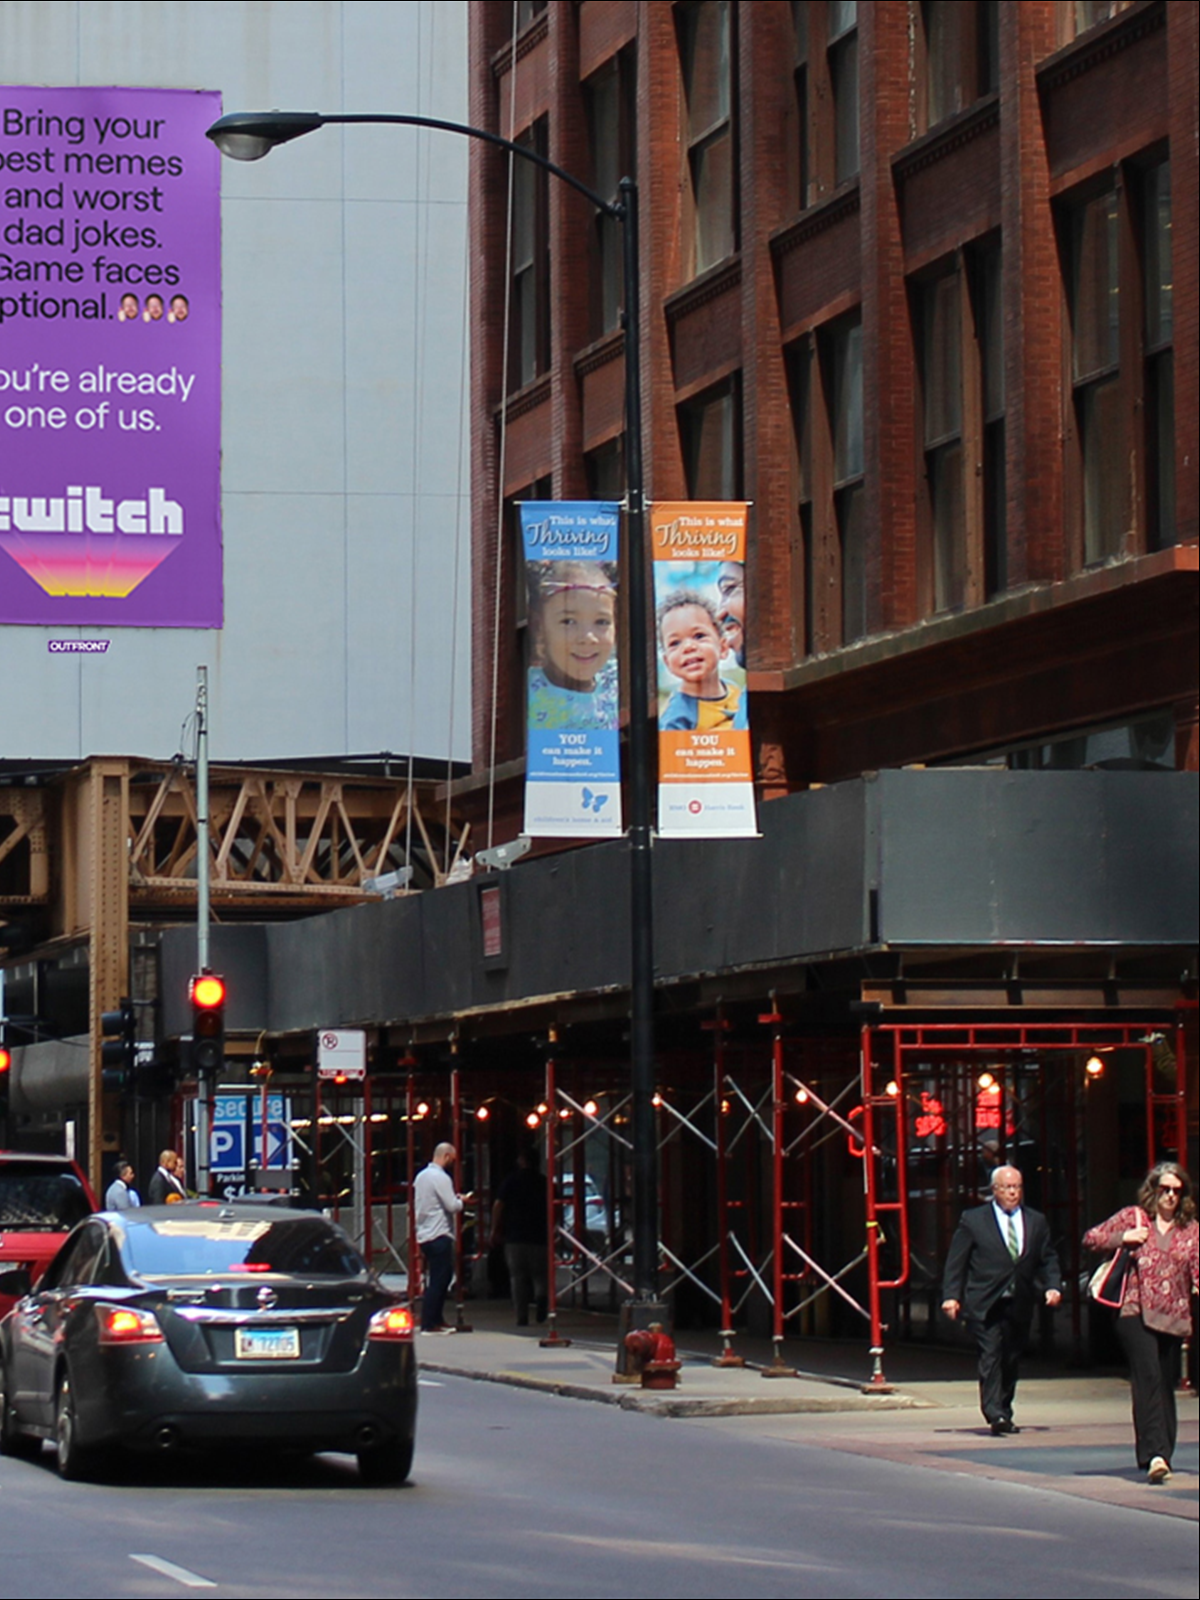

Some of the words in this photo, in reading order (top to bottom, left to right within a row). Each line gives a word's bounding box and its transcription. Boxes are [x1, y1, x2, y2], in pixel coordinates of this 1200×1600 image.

[3, 108, 85, 144] Bring
[94, 117, 165, 144] your
[65, 152, 183, 176] memes
[4, 183, 64, 209] and
[73, 186, 163, 212] worst
[3, 218, 64, 245] dad
[71, 219, 163, 253] jokes.
[92, 256, 180, 285] faces
[78, 365, 195, 401] already
[4, 406, 67, 428] one
[75, 402, 109, 429] of
[118, 409, 161, 431] us.
[549, 516, 574, 525] This
[577, 516, 587, 525] is
[589, 516, 616, 526] what
[678, 516, 703, 526] This
[705, 516, 715, 526] is
[717, 516, 744, 526] what
[526, 519, 610, 554] Thriving
[655, 519, 737, 555] Thriving
[542, 546, 571, 556] looks
[672, 548, 700, 557] looks
[50, 642, 107, 651] OUTFRONT
[558, 733, 587, 745] YOU
[690, 734, 719, 746] YOU
[542, 747, 561, 755] can
[563, 746, 592, 755] make
[675, 748, 694, 756] can
[696, 747, 724, 756] make
[552, 756, 592, 768] happen.
[685, 758, 725, 768] happen.
[210, 1130, 234, 1162] P
[217, 1173, 246, 1182] Parkin
